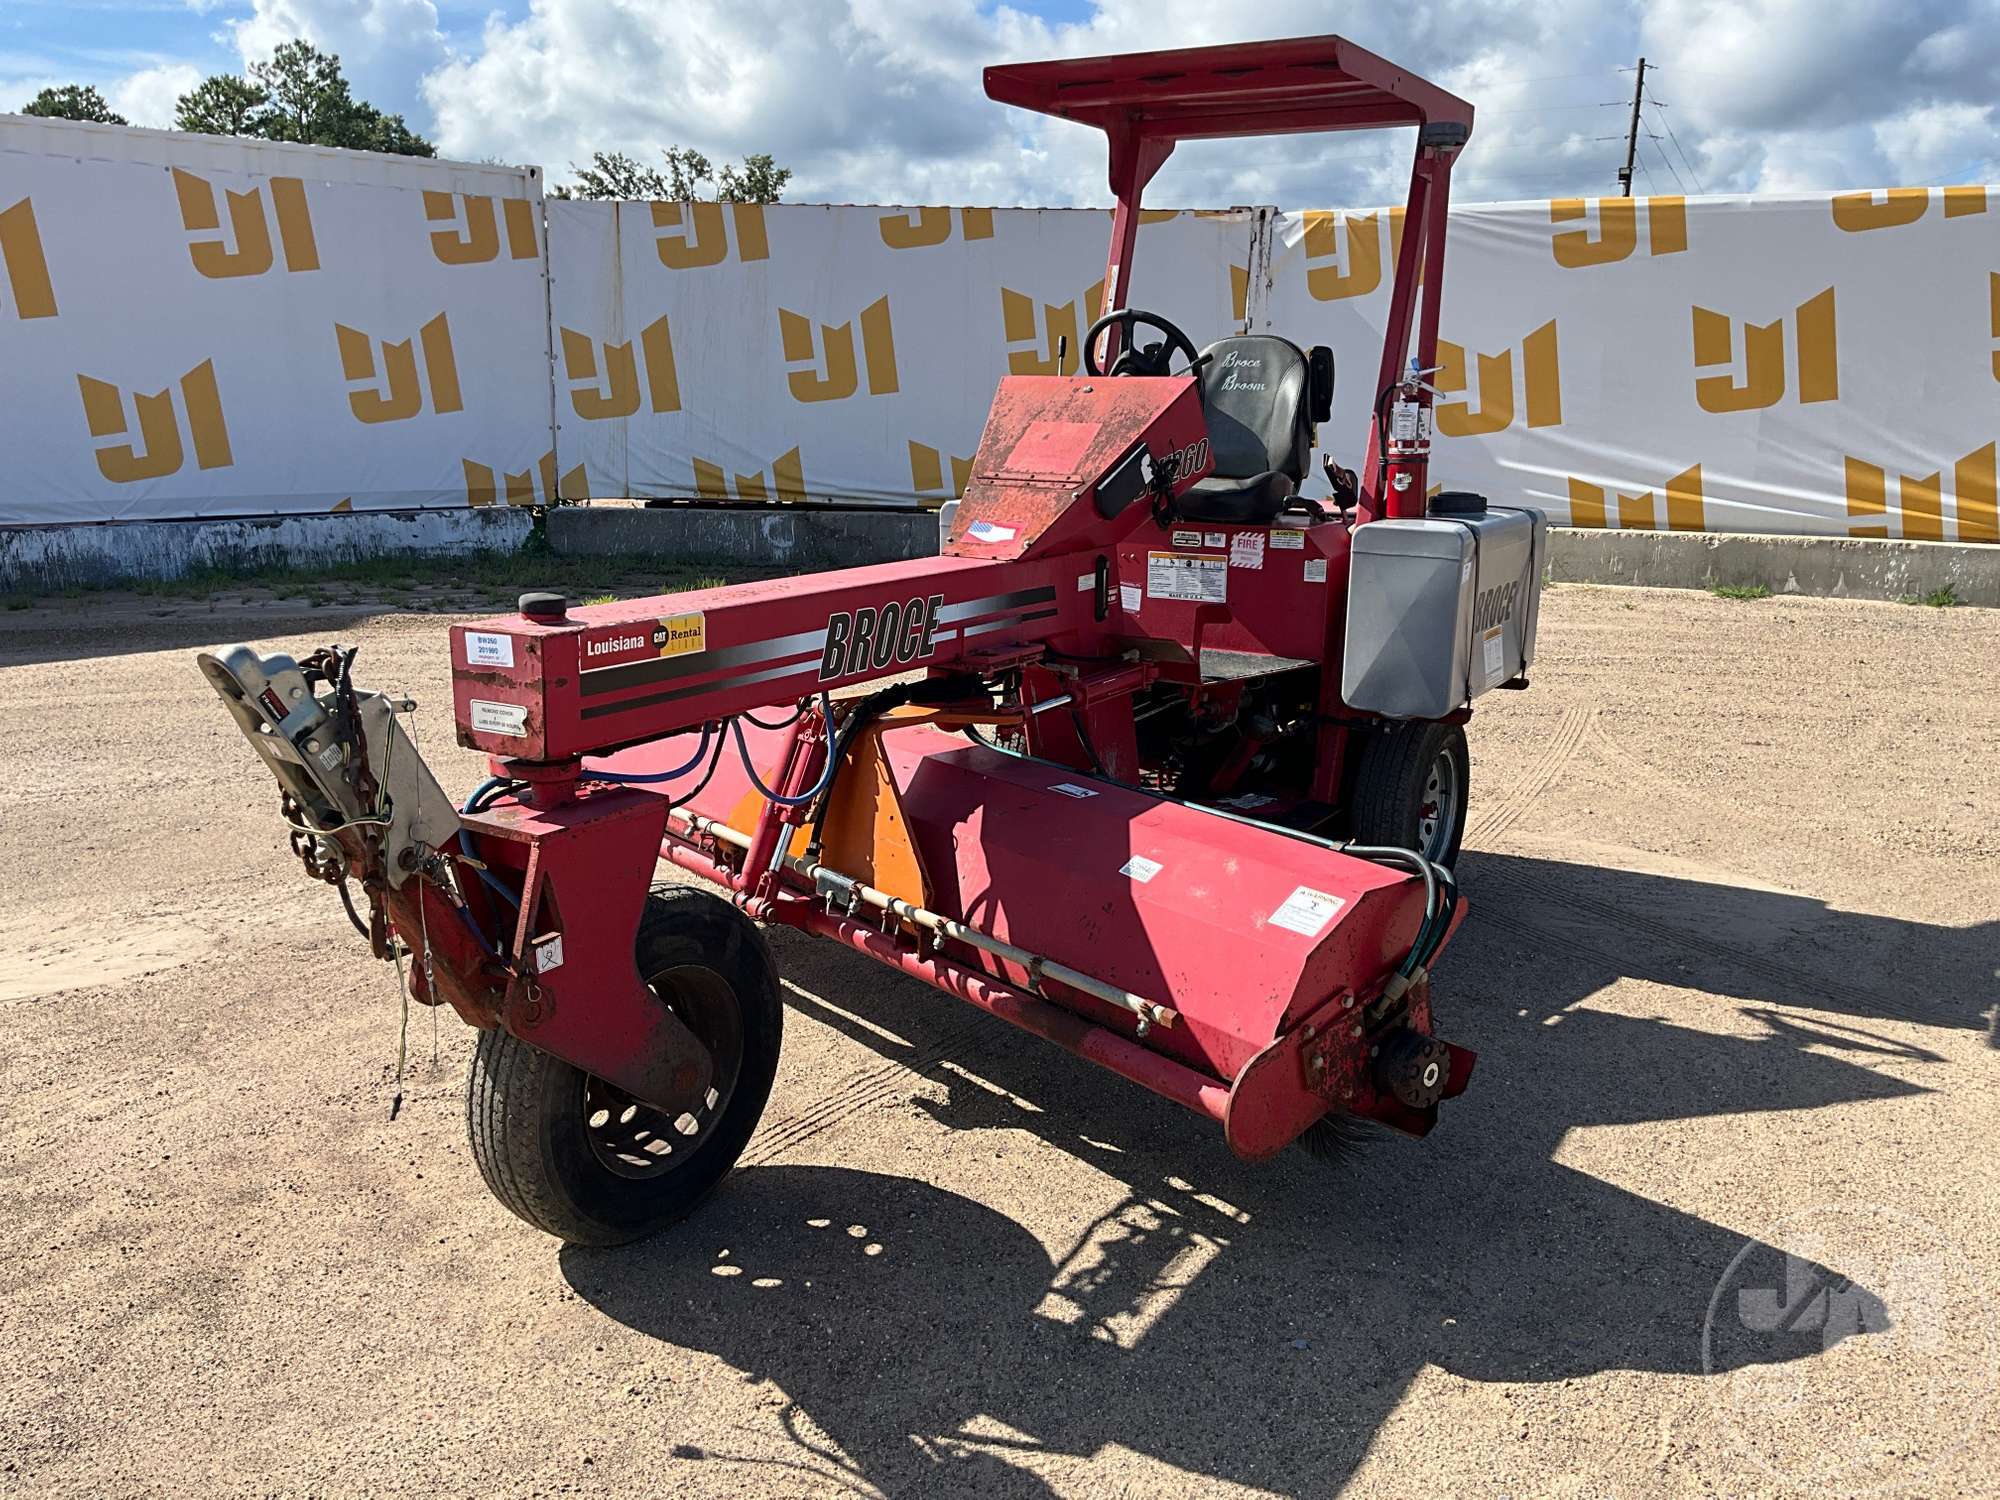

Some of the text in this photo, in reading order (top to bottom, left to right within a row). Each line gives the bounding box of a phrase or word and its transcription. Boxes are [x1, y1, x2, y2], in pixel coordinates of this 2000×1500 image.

[1222, 351, 1261, 368] Broce
[1221, 373, 1265, 391] Broom
[1237, 538, 1258, 550] FIRE
[1475, 580, 1519, 635] BROCE
[587, 626, 701, 656] Louisiana CAT Rental
[818, 594, 944, 682] BROCE
